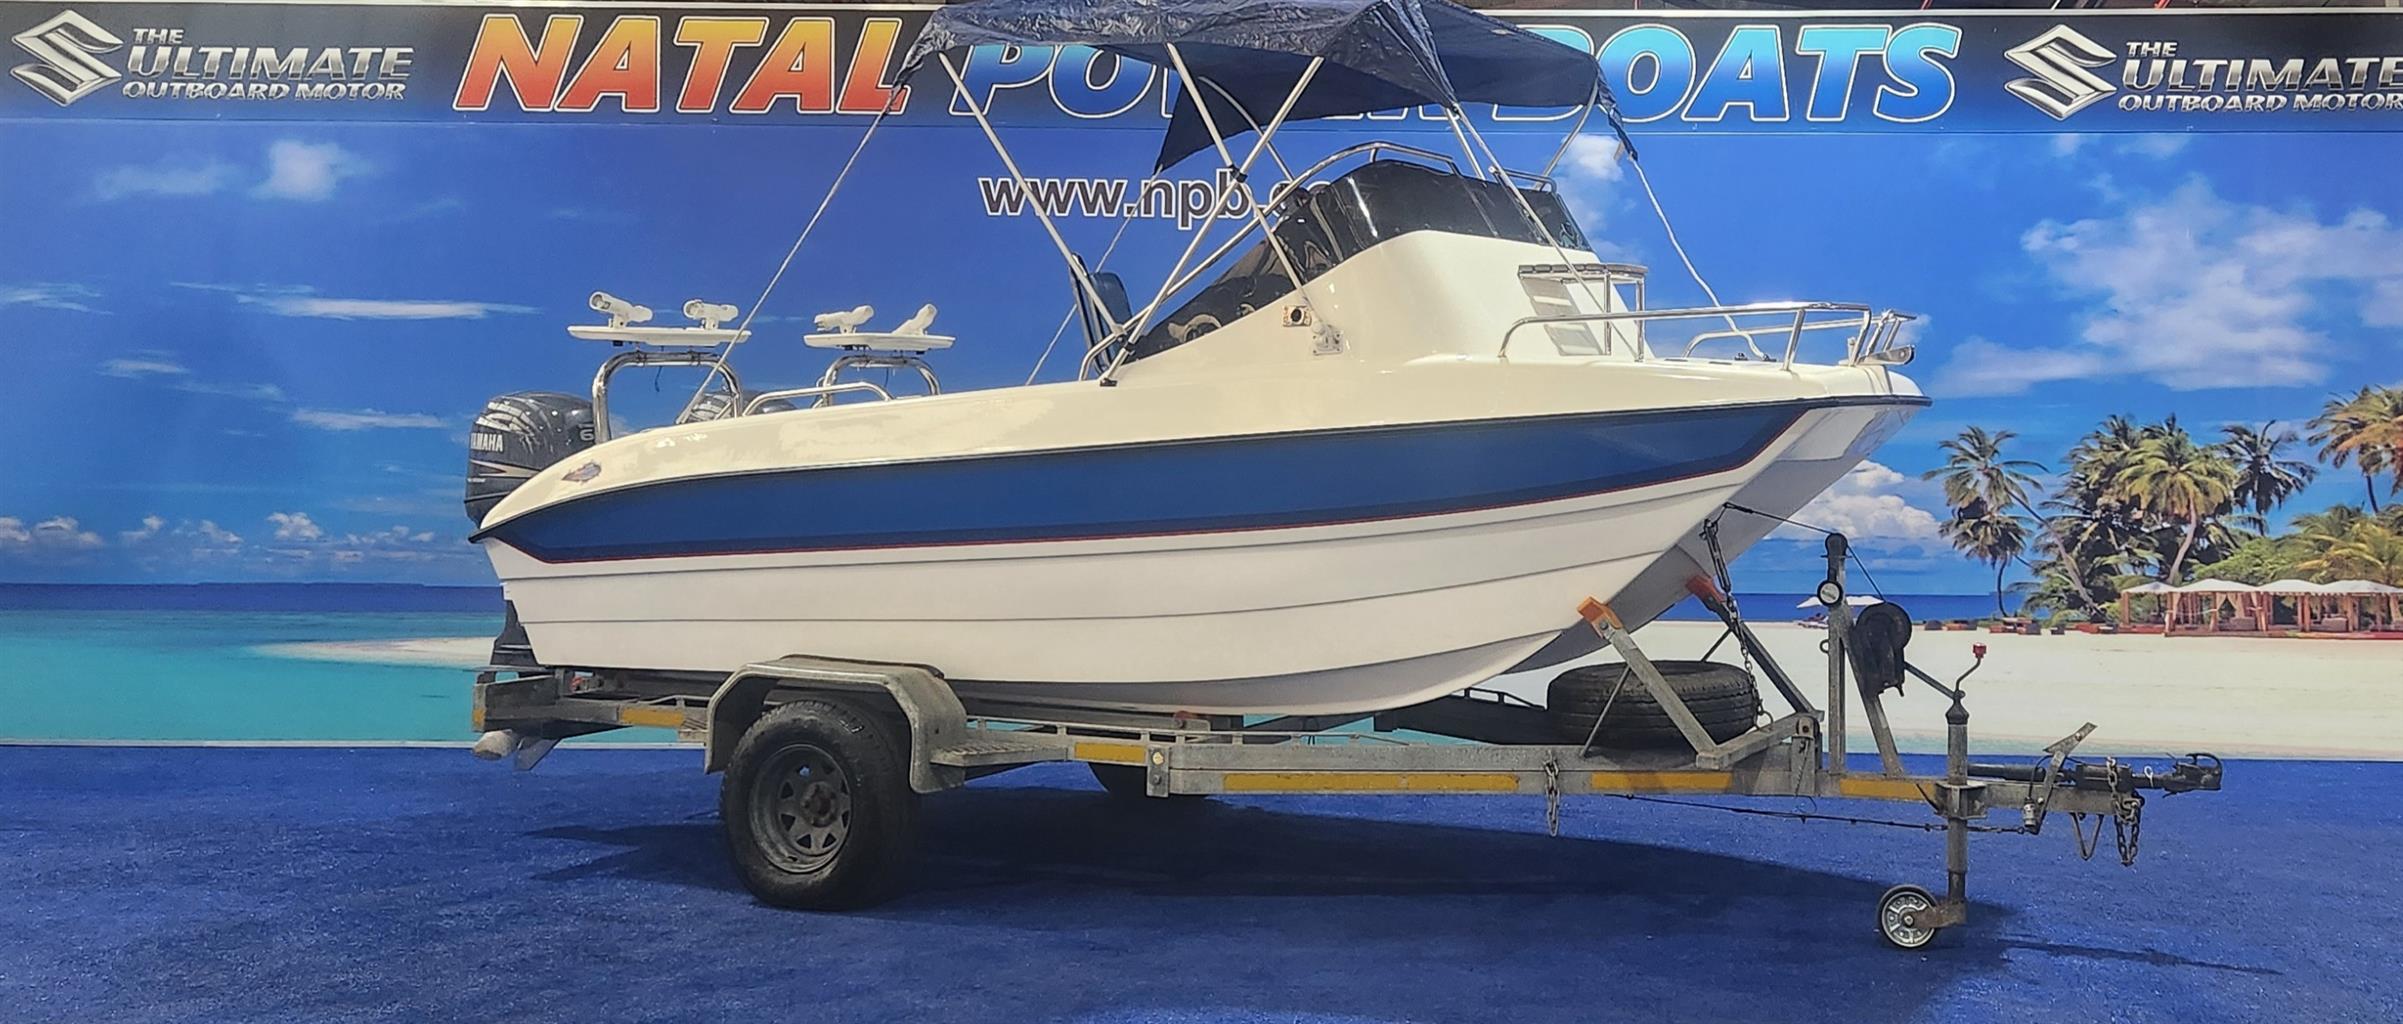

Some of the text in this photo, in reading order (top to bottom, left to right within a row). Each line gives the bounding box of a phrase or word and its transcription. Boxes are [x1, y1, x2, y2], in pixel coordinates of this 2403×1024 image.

[132, 28, 184, 44] THE
[2126, 42, 2177, 57] THE
[127, 47, 414, 81] ULTIMATE
[453, 14, 910, 114] NATAL
[2122, 56, 2403, 92] ULTIMATE
[122, 81, 408, 100] OUTBOARD MOTOR
[2118, 92, 2403, 113] OUTBOARD MOTOR
